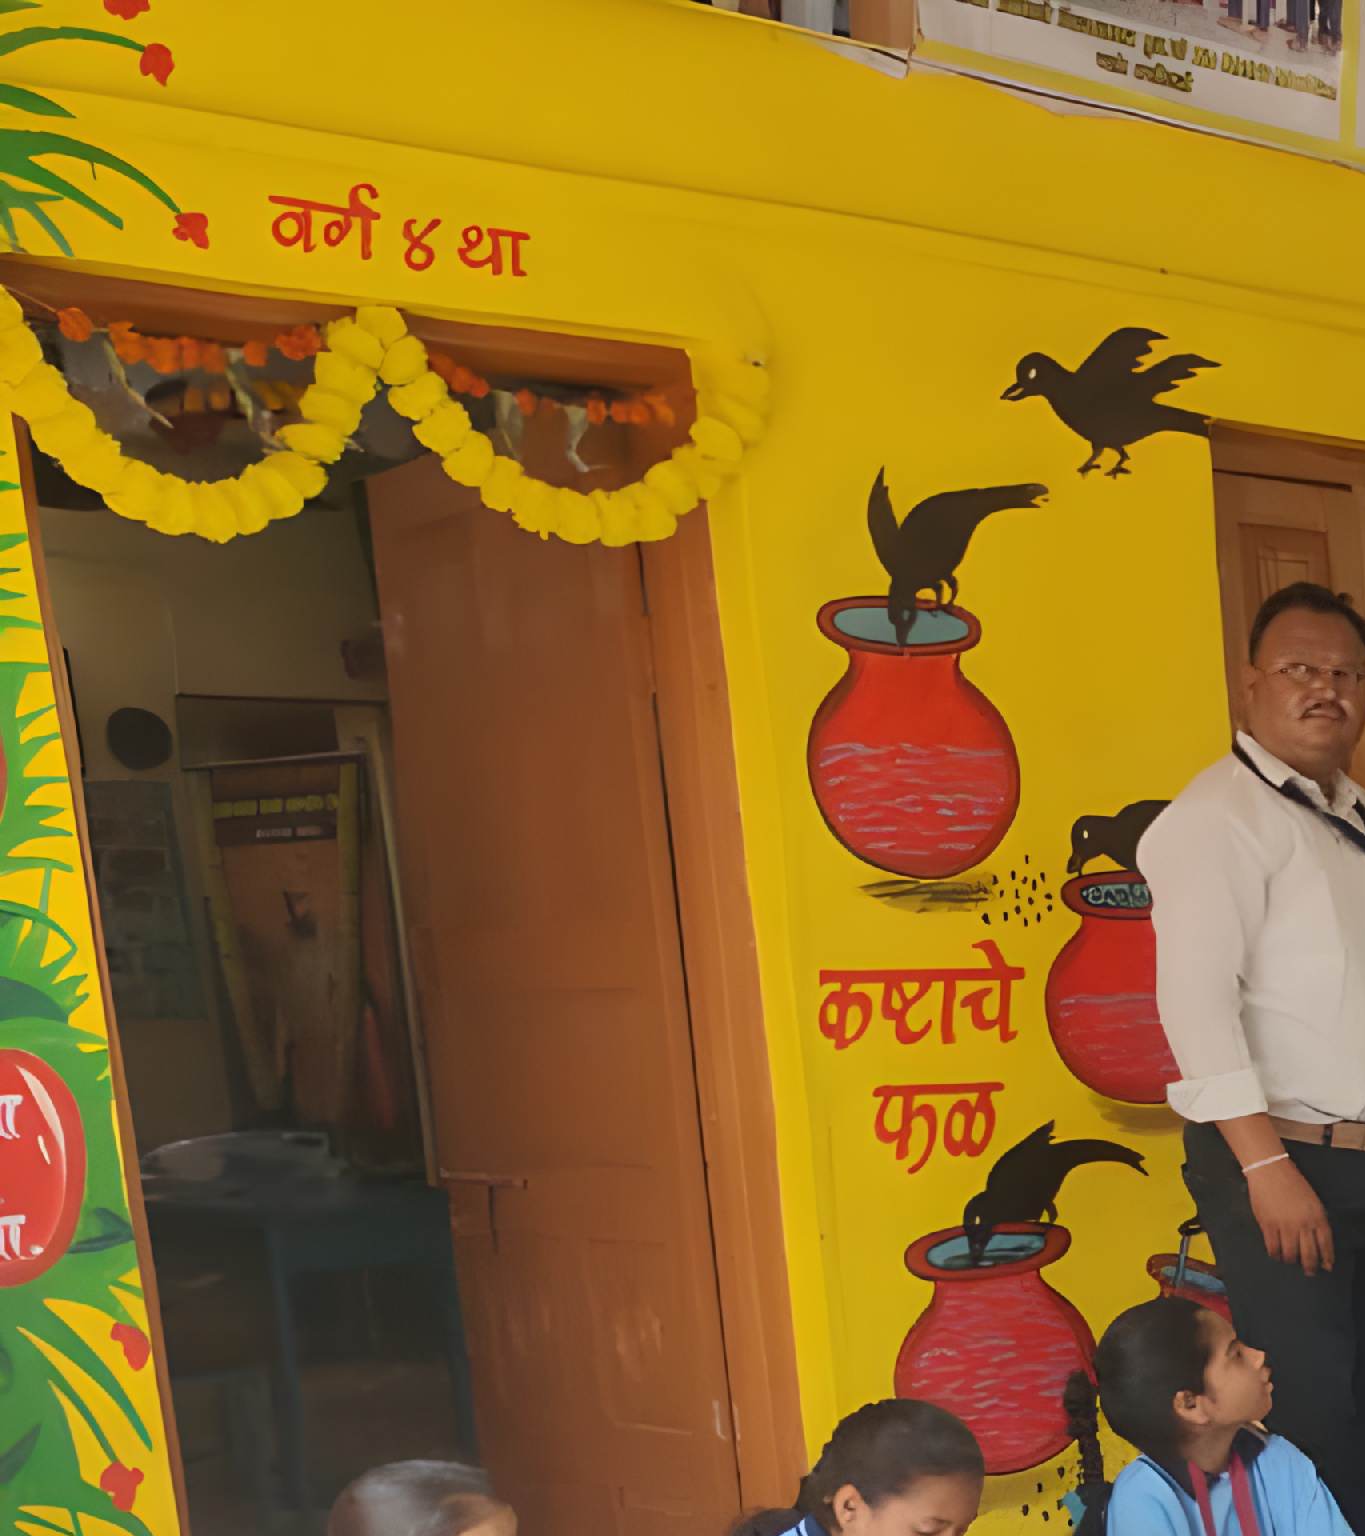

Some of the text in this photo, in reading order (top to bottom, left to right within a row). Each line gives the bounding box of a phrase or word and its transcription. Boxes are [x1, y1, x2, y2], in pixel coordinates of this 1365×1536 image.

[268, 184, 530, 278] वर्ग ४ था
[819, 938, 1026, 1051] कष्टाचे
[872, 1081, 1005, 1175] फळ
